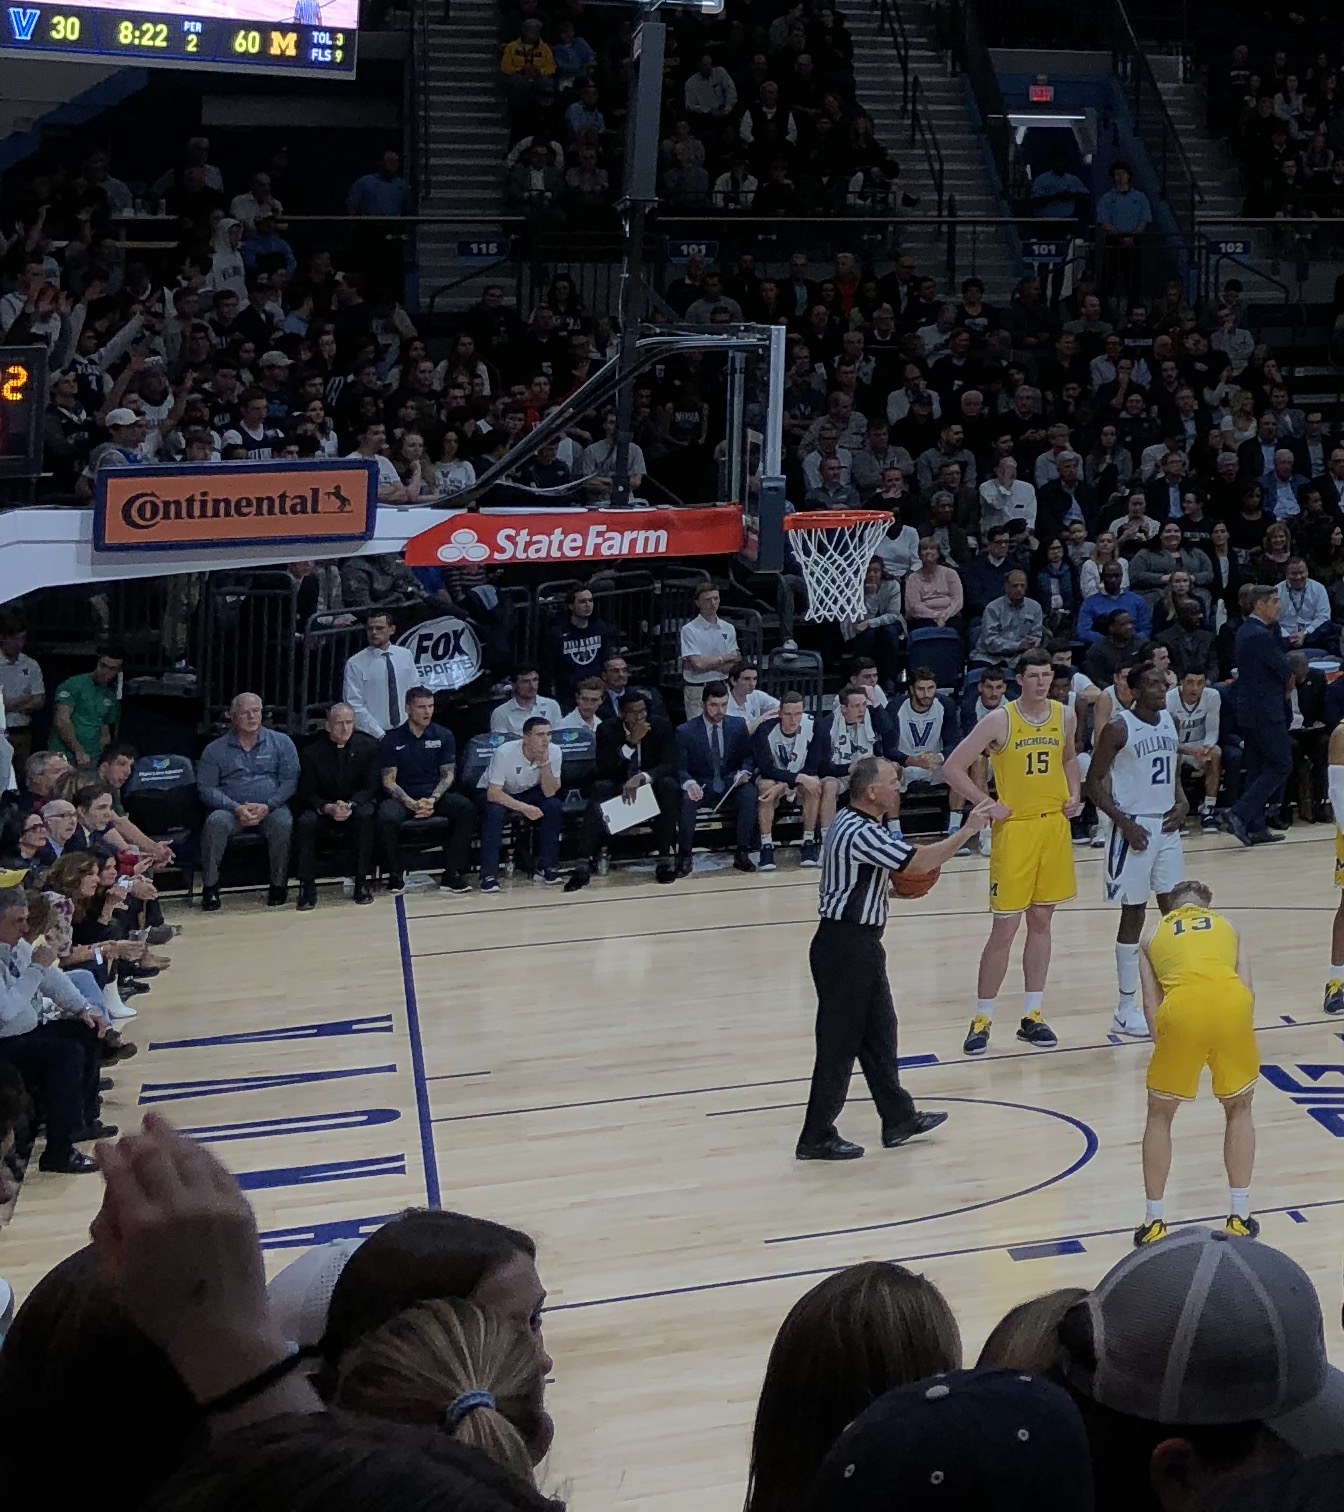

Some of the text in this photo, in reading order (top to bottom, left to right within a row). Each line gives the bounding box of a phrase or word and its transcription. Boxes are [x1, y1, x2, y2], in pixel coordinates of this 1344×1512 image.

[49, 15, 82, 42] 30
[118, 19, 170, 49] 8:22
[232, 29, 262, 54] 60
[183, 19, 203, 34] PER
[184, 34, 199, 53] 2
[311, 31, 345, 46] TOL 3
[311, 48, 345, 64] FLS 9
[679, 242, 708, 257] 101
[1031, 243, 1057, 256] 101
[1219, 242, 1245, 255] 102
[0, 362, 30, 402] 2
[121, 487, 321, 530] Continental
[414, 627, 470, 666] FOX
[1015, 736, 1060, 750] MICHIGAN
[1025, 751, 1051, 776] 15
[1151, 755, 1171, 786] 21
[1172, 914, 1213, 937] 13
